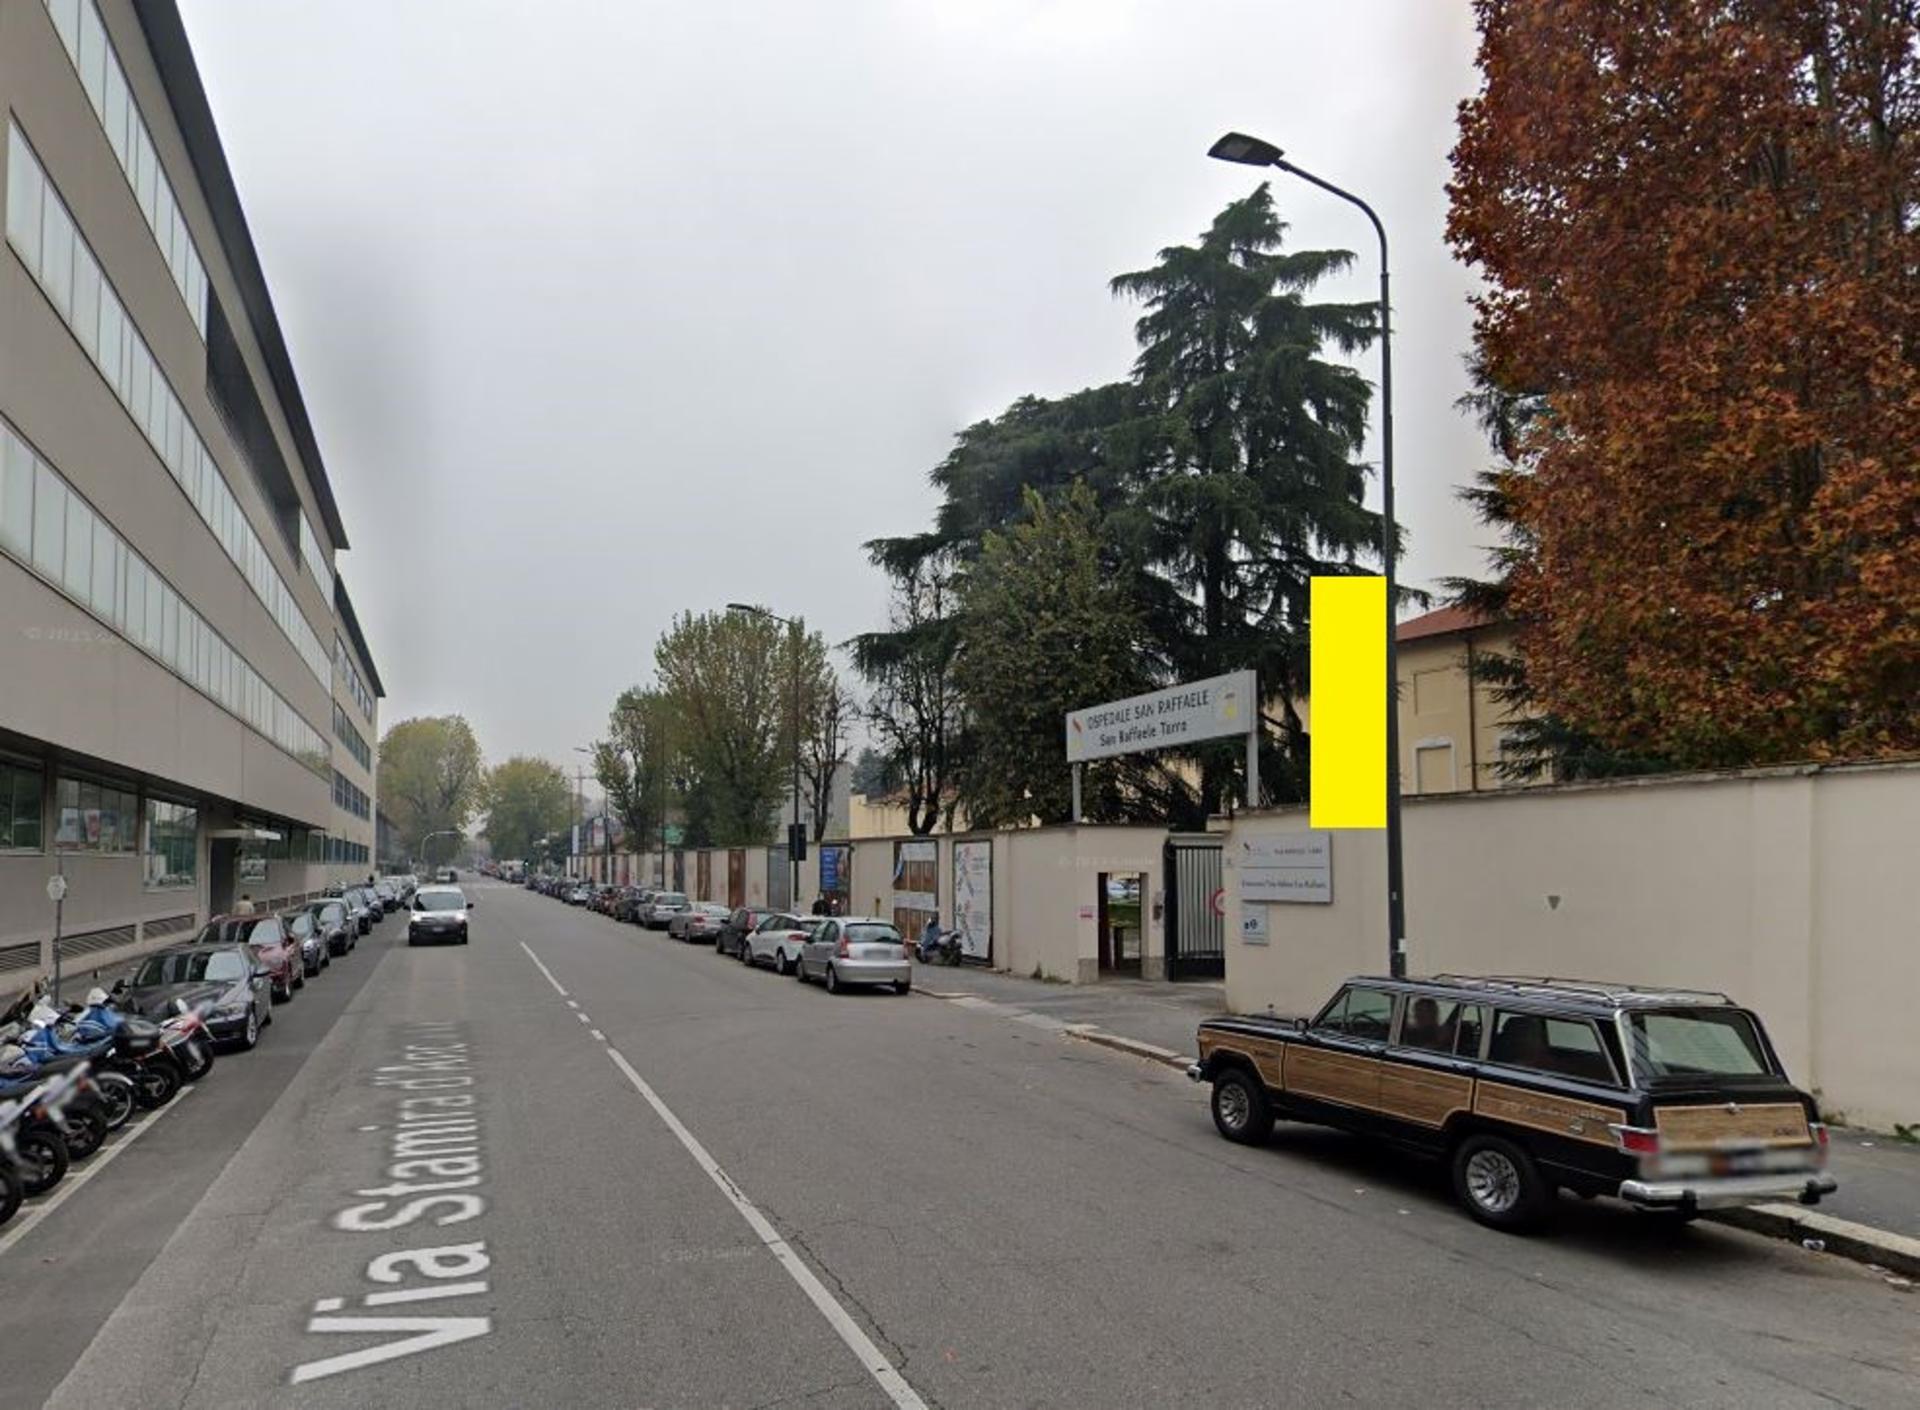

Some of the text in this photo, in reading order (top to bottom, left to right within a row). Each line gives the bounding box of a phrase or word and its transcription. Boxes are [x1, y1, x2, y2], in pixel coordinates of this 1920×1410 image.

[1087, 689, 1209, 730] OSPEDALE SAN RAFFAELE
[1099, 733, 1117, 747] San
[1119, 724, 1156, 744] Raffaele
